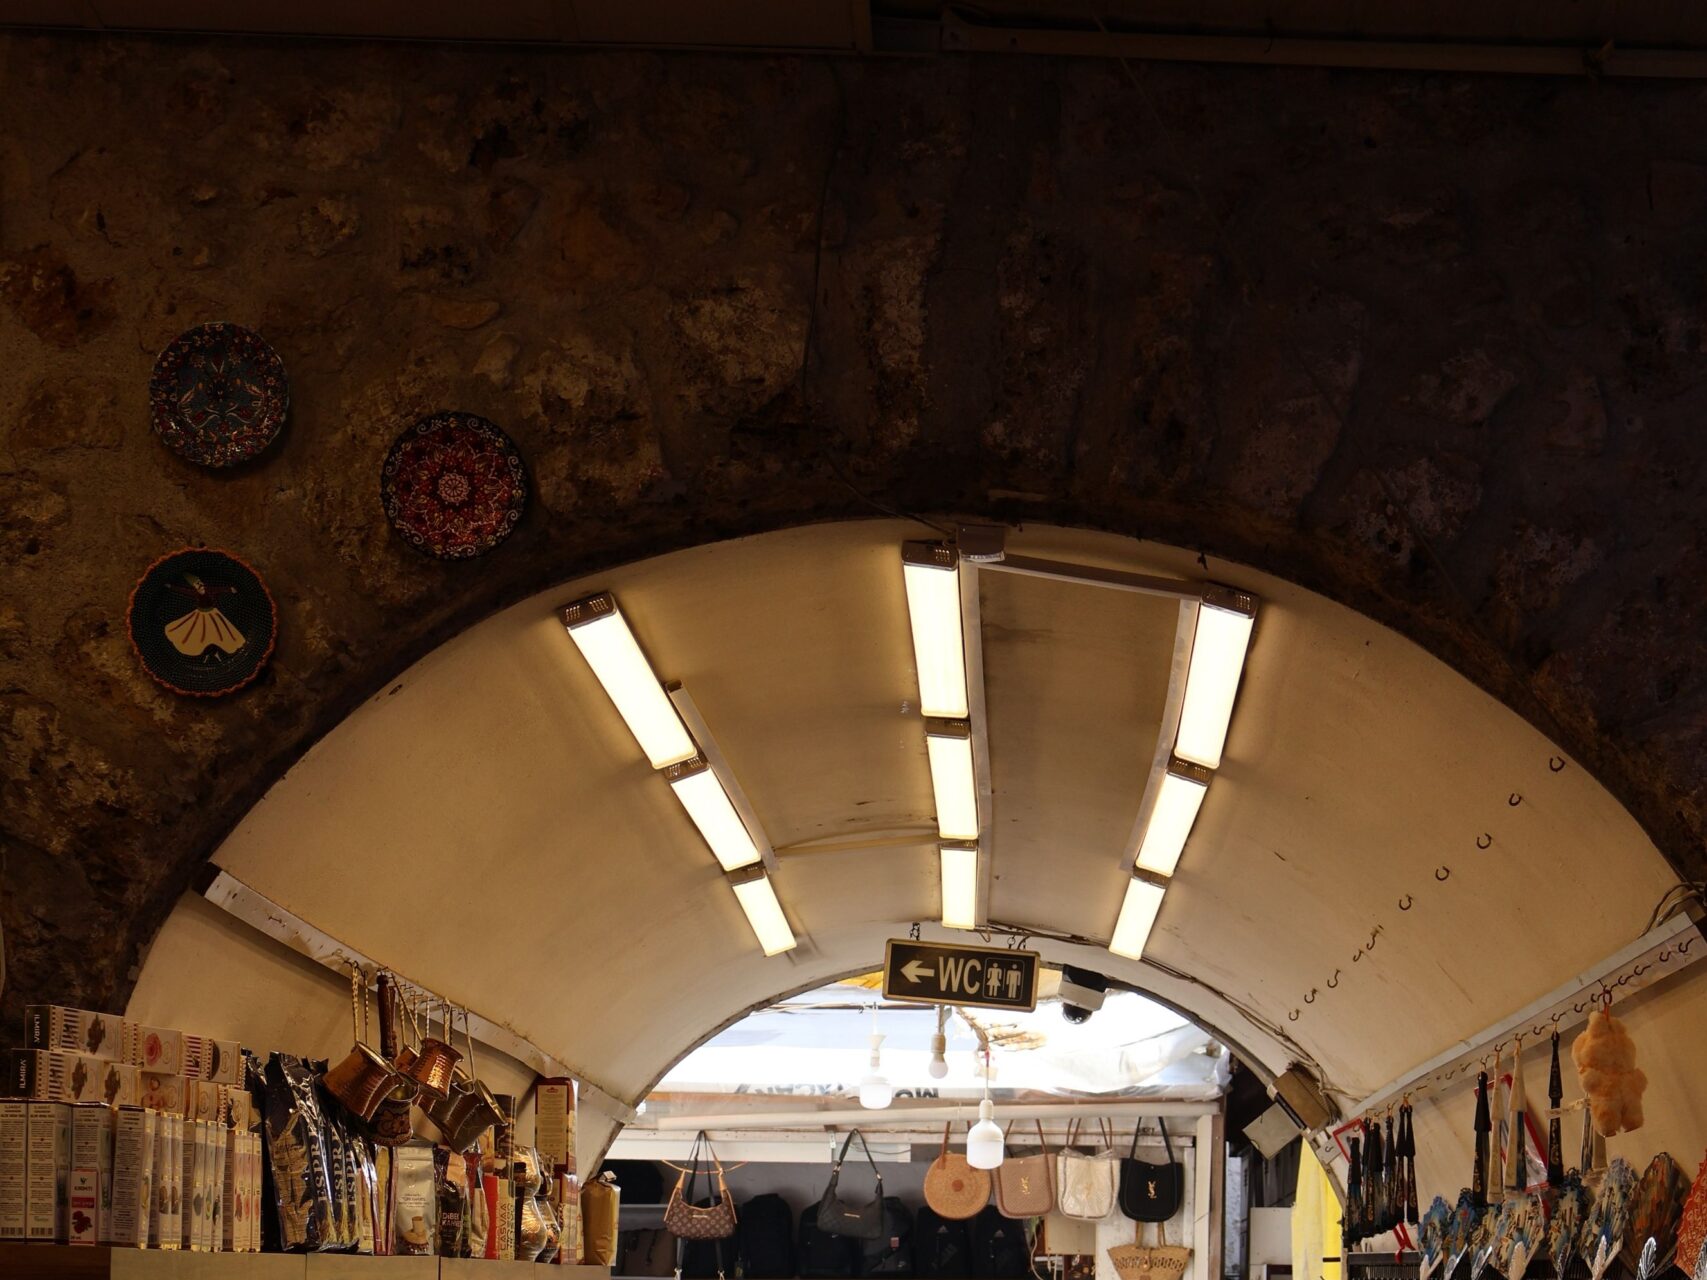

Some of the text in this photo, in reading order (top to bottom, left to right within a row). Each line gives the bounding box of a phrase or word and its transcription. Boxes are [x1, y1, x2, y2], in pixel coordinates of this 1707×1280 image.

[938, 956, 982, 995] WC
[33, 1013, 41, 1044] ILMIRA
[18, 1058, 27, 1090] ILMIRA
